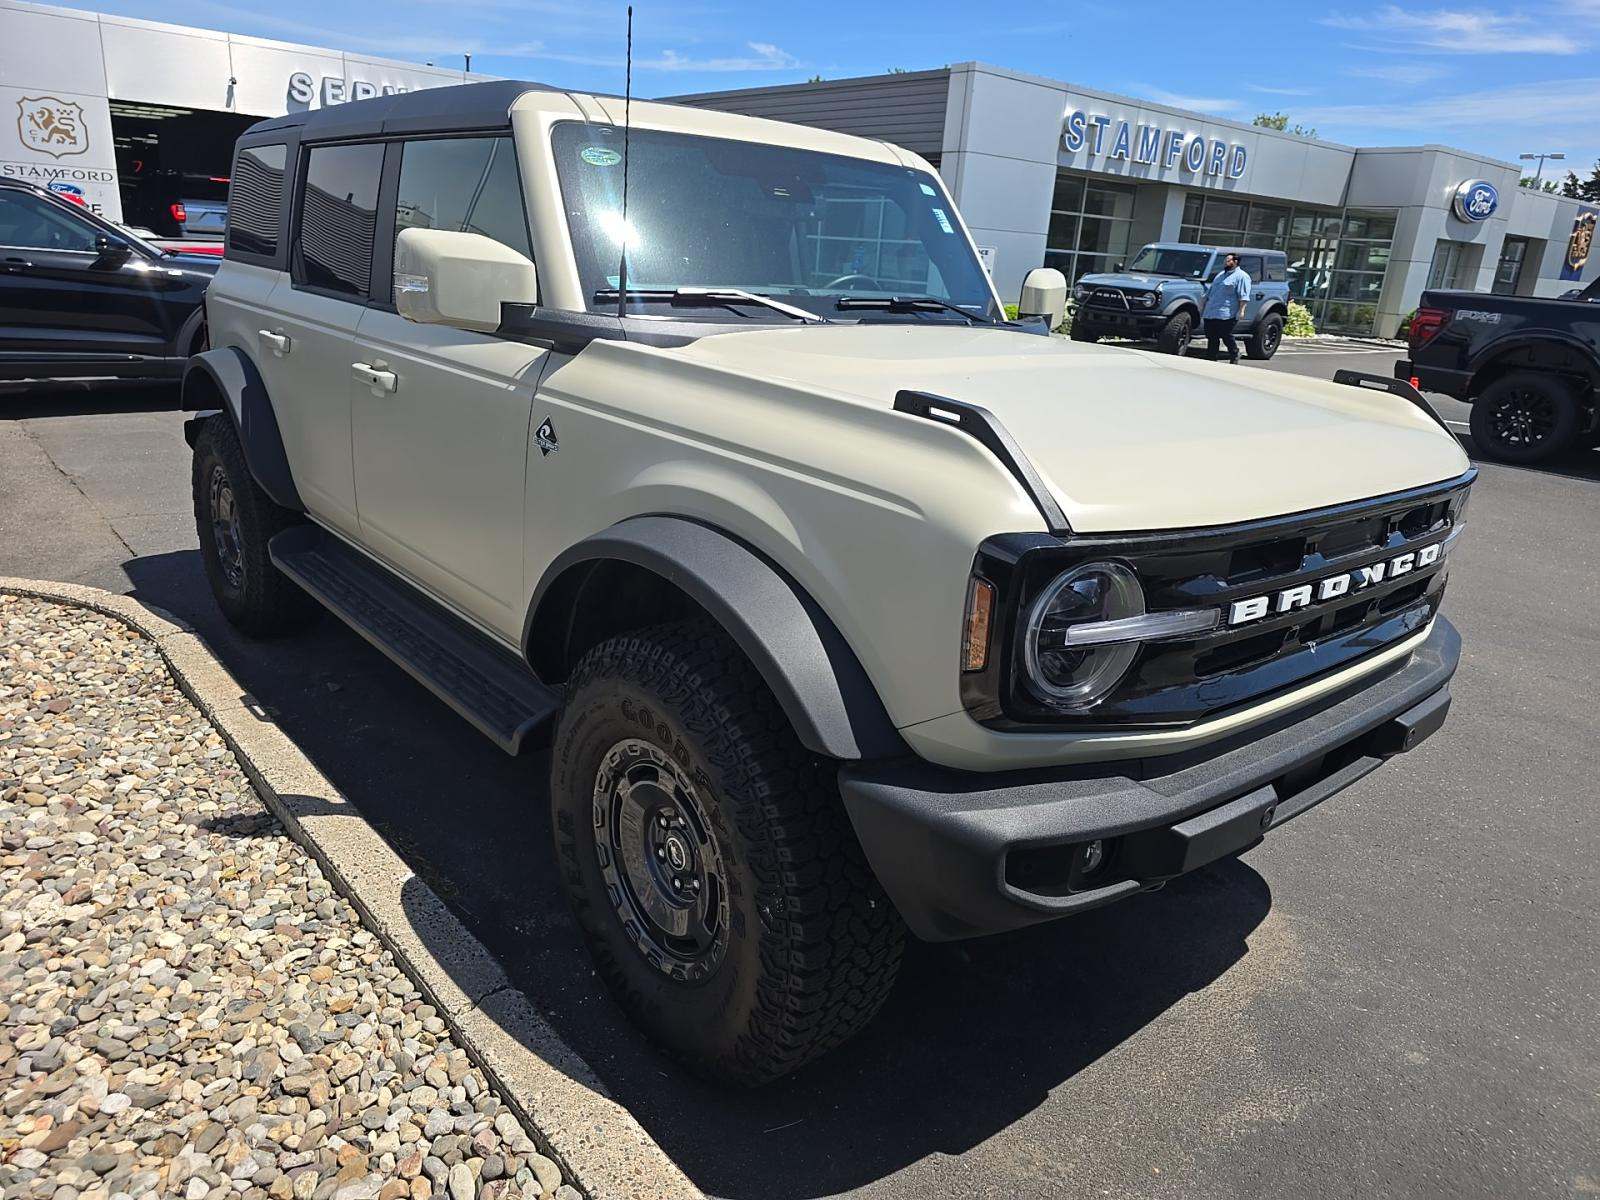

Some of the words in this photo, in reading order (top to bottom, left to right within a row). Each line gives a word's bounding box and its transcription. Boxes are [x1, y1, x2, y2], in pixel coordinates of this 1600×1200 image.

[1065, 110, 1247, 178] STAMFORD
[3, 165, 113, 182] STAMFORD
[1468, 188, 1496, 216] Ford
[1228, 543, 1440, 625] BRONCO
